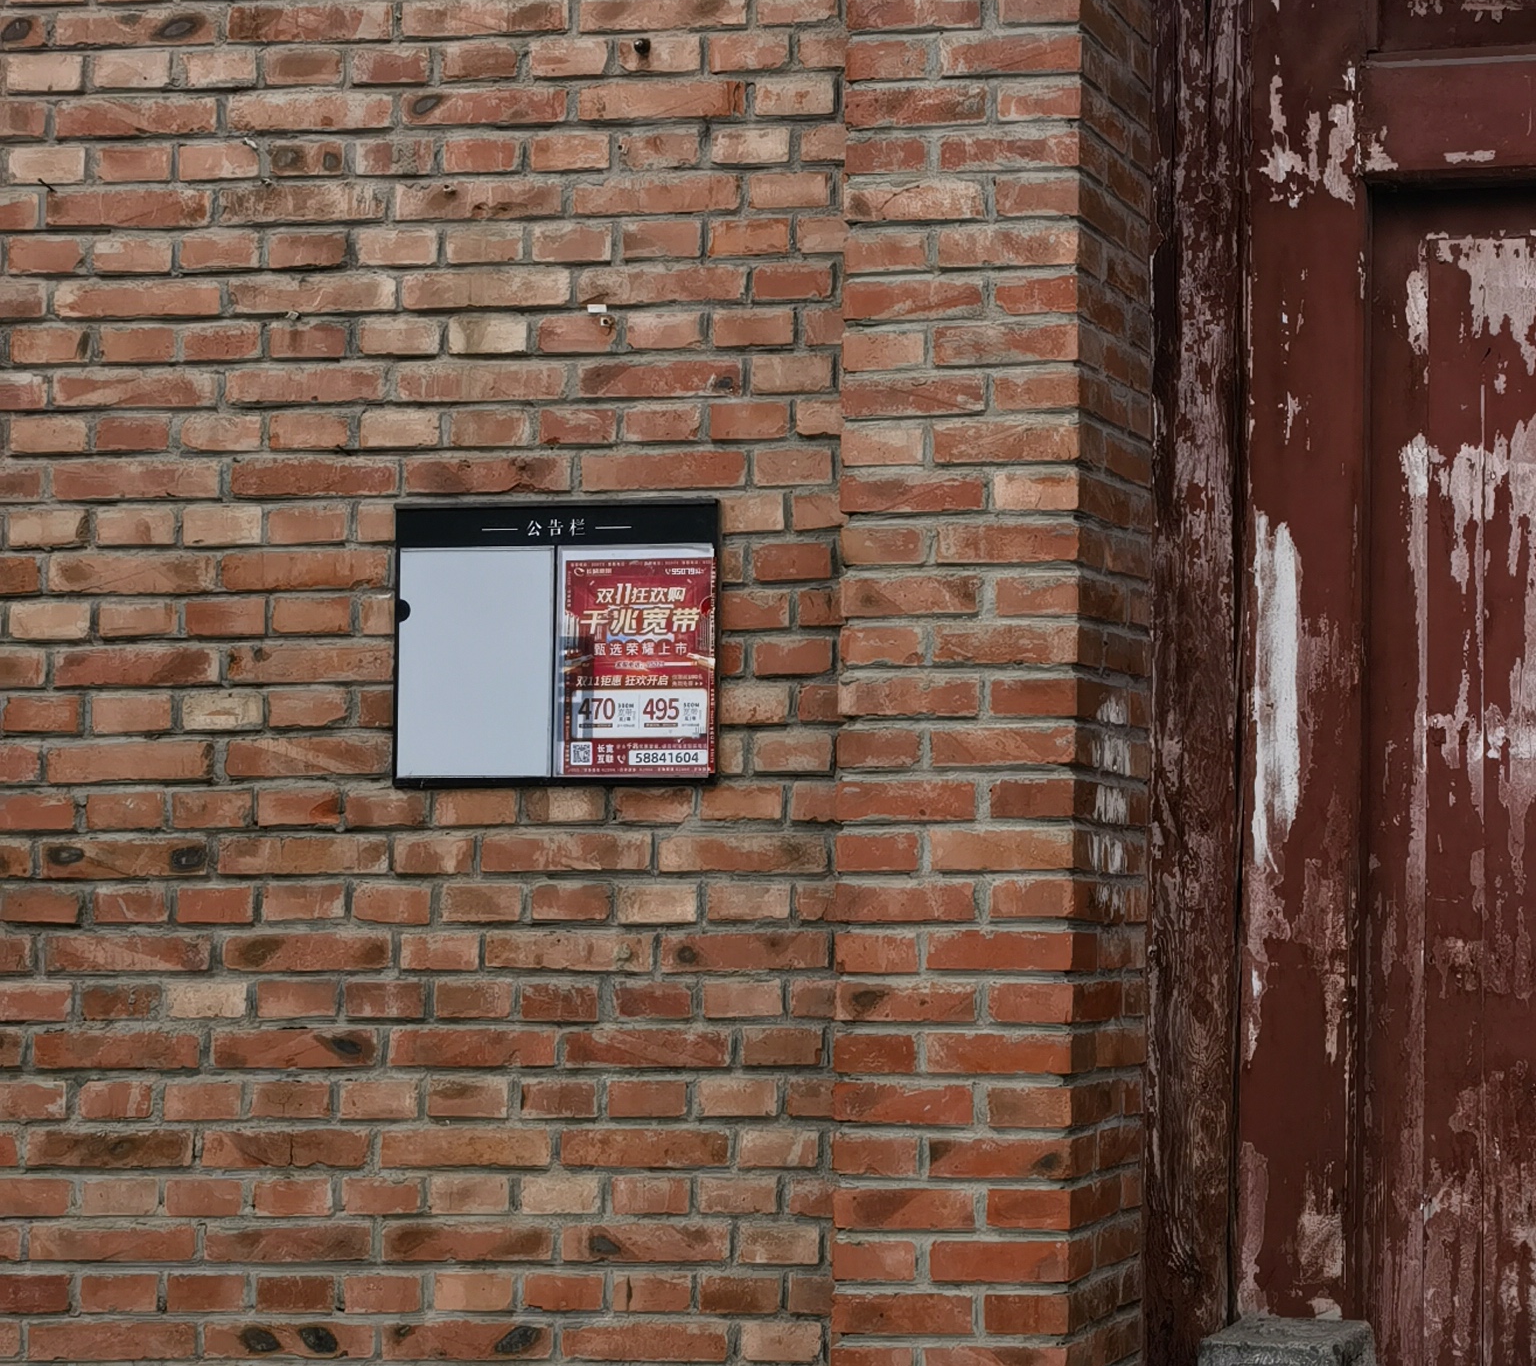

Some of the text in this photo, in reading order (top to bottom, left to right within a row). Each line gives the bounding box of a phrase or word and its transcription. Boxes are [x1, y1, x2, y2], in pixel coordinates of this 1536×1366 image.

[526, 518, 587, 537] 公告栏
[595, 583, 687, 604] 双11狂欢购
[580, 607, 701, 636] 千兆宽带
[593, 641, 689, 657] 甄选荣耀上市
[575, 674, 623, 687] 双11钜惠
[624, 674, 669, 686] 狂欢开启
[577, 697, 616, 721] 470
[642, 697, 680, 721] 495
[597, 743, 615, 754] 长宽
[635, 752, 699, 764] 58841604
